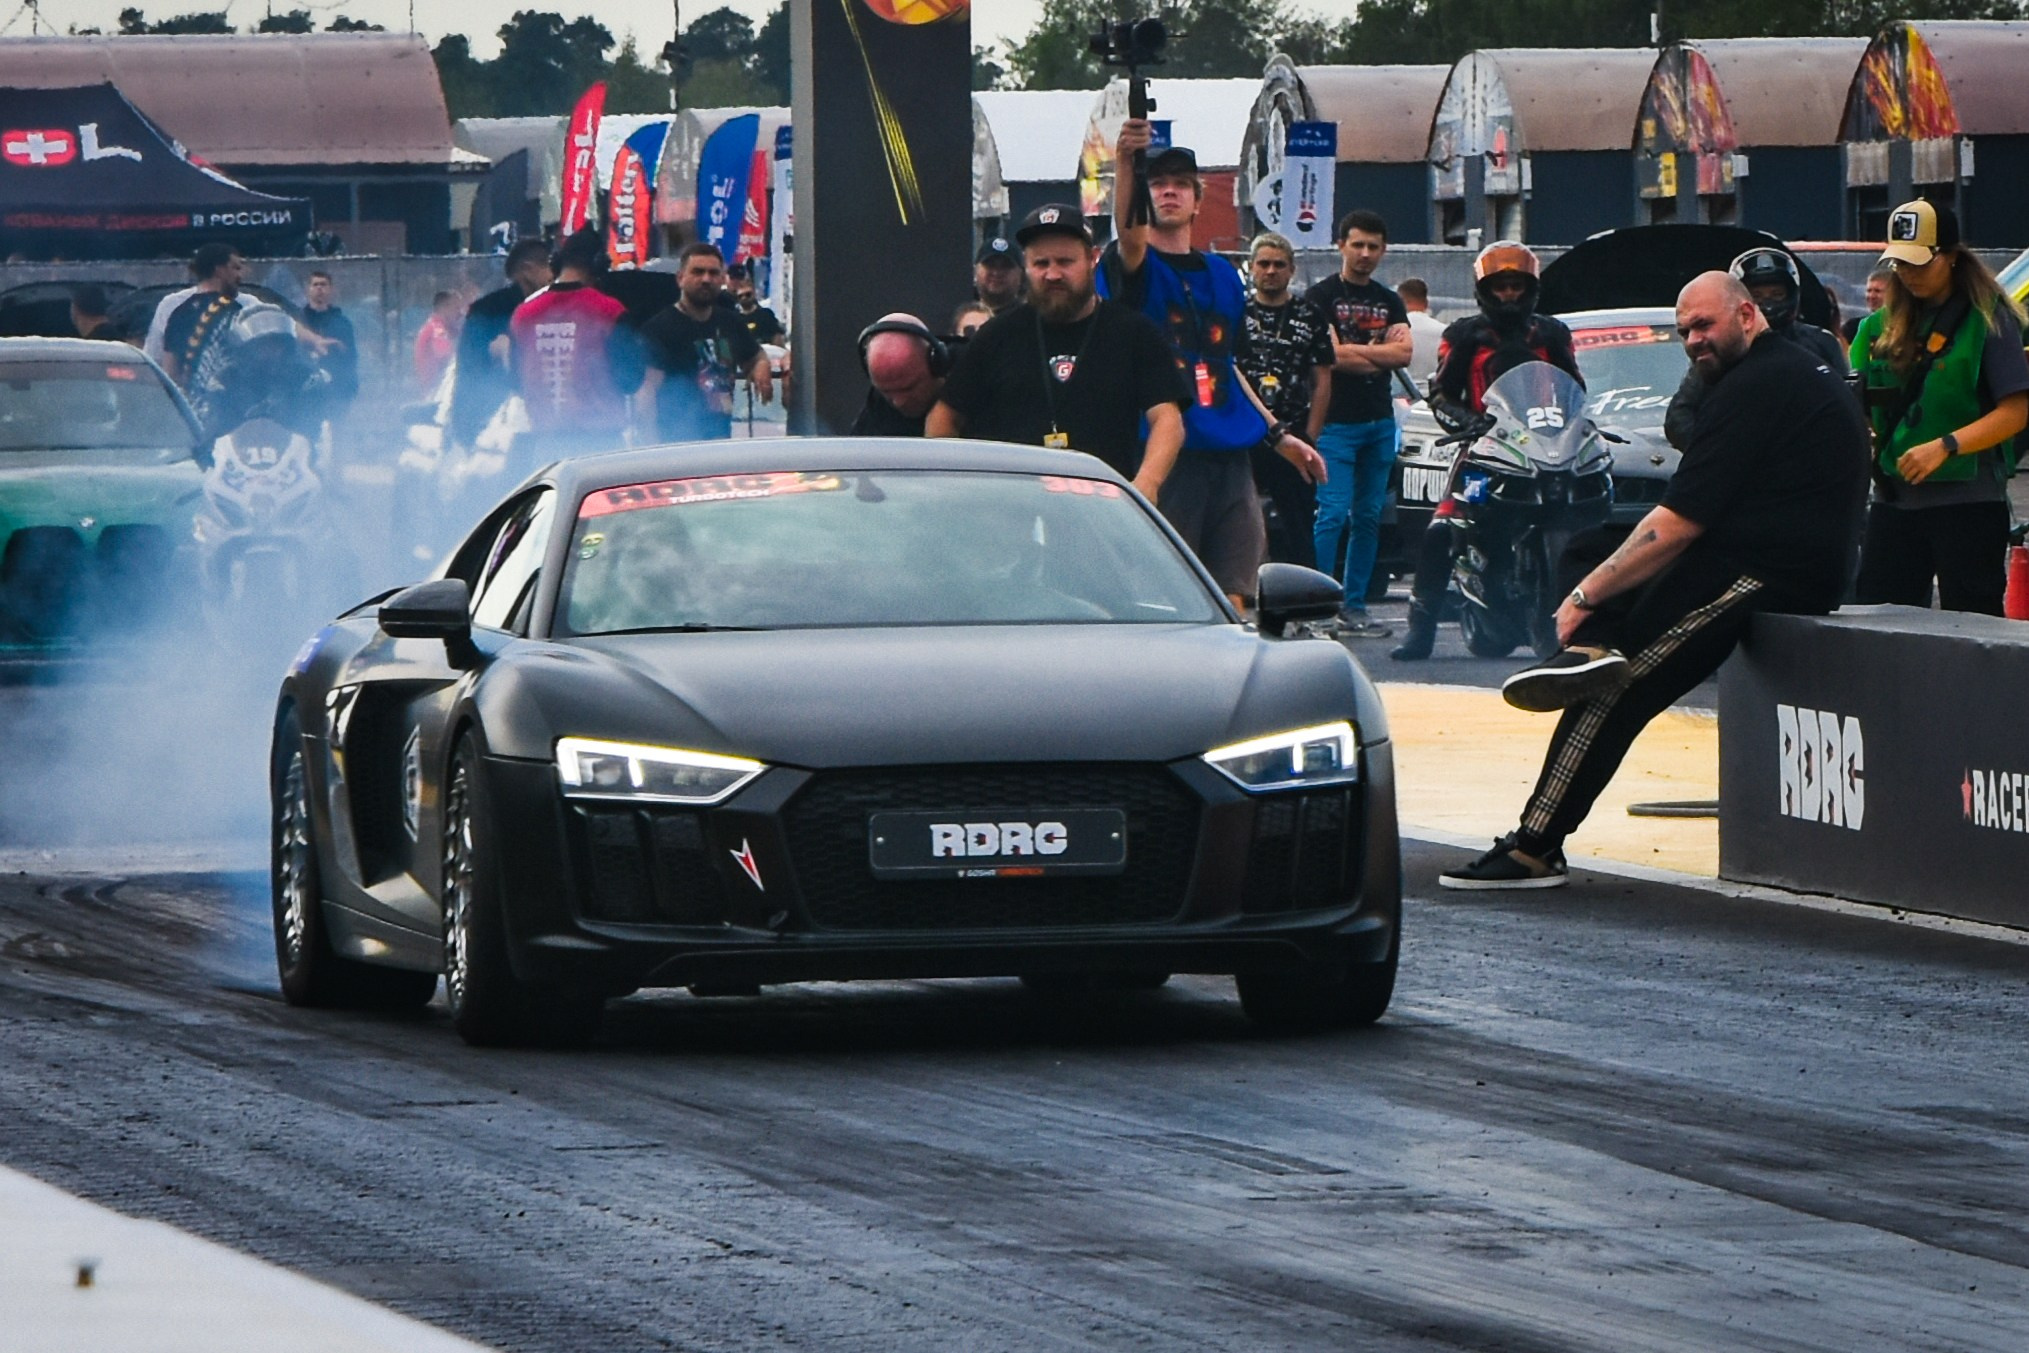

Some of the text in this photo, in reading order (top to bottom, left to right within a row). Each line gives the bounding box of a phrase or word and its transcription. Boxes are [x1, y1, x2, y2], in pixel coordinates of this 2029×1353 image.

[192, 215, 204, 227] В
[210, 210, 292, 226] РОССИИ
[1526, 406, 1564, 430] 25
[669, 488, 770, 505] TURBOTECH
[1777, 703, 1865, 831] RDRC
[929, 821, 1068, 858] RDRC
